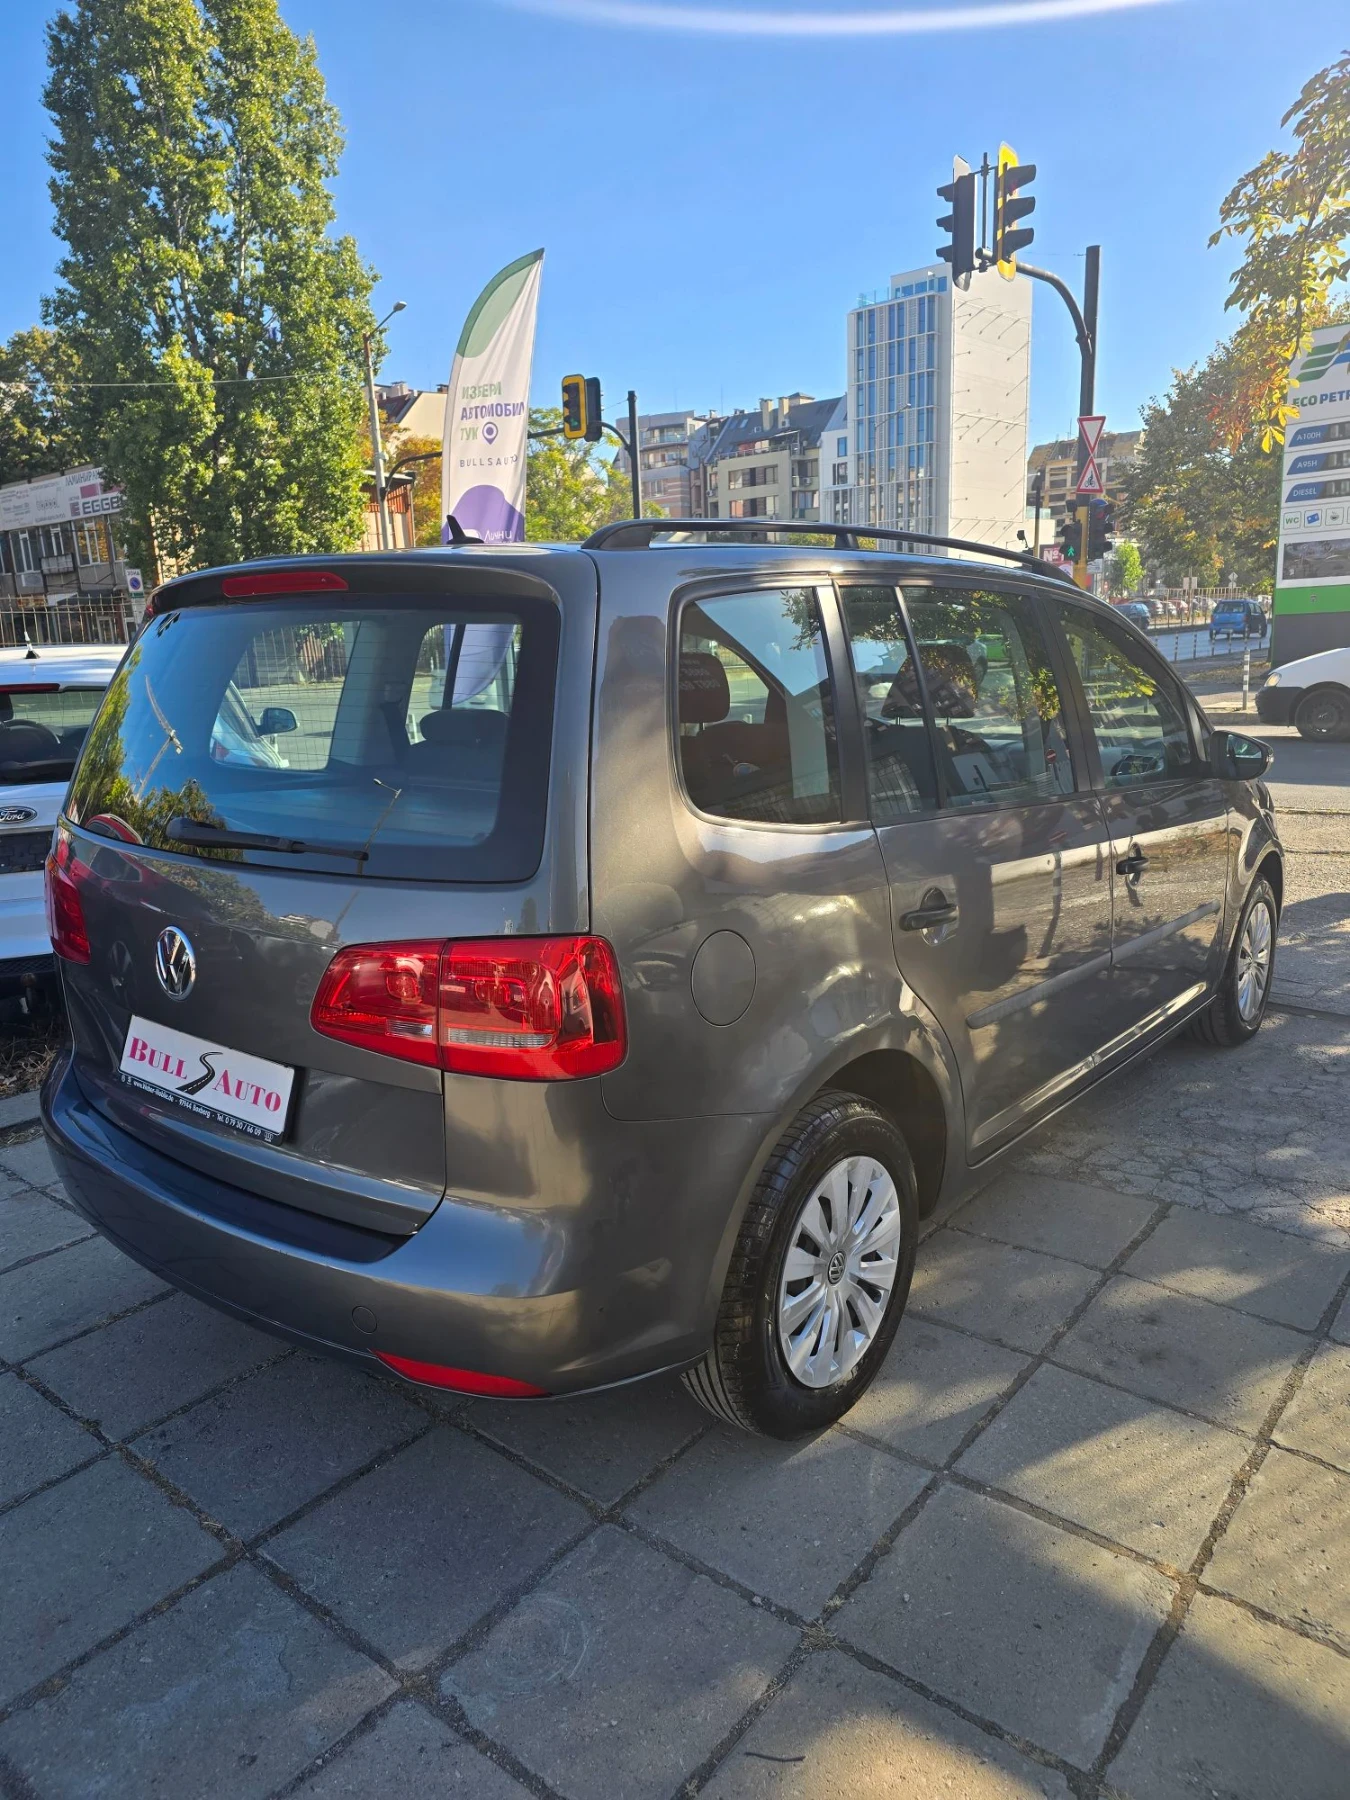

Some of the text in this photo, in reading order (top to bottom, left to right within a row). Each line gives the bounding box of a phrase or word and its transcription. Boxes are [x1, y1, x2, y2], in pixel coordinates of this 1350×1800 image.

[1292, 395, 1318, 407] ECO
[460, 402, 525, 421] АВТОМОБИЛ
[460, 426, 479, 442] ТУК
[1296, 460, 1318, 469] A95H
[1292, 487, 1317, 497] DIESEL
[1285, 517, 1299, 525] WC
[127, 1036, 188, 1080] BULL
[212, 1069, 282, 1113] AUTO
